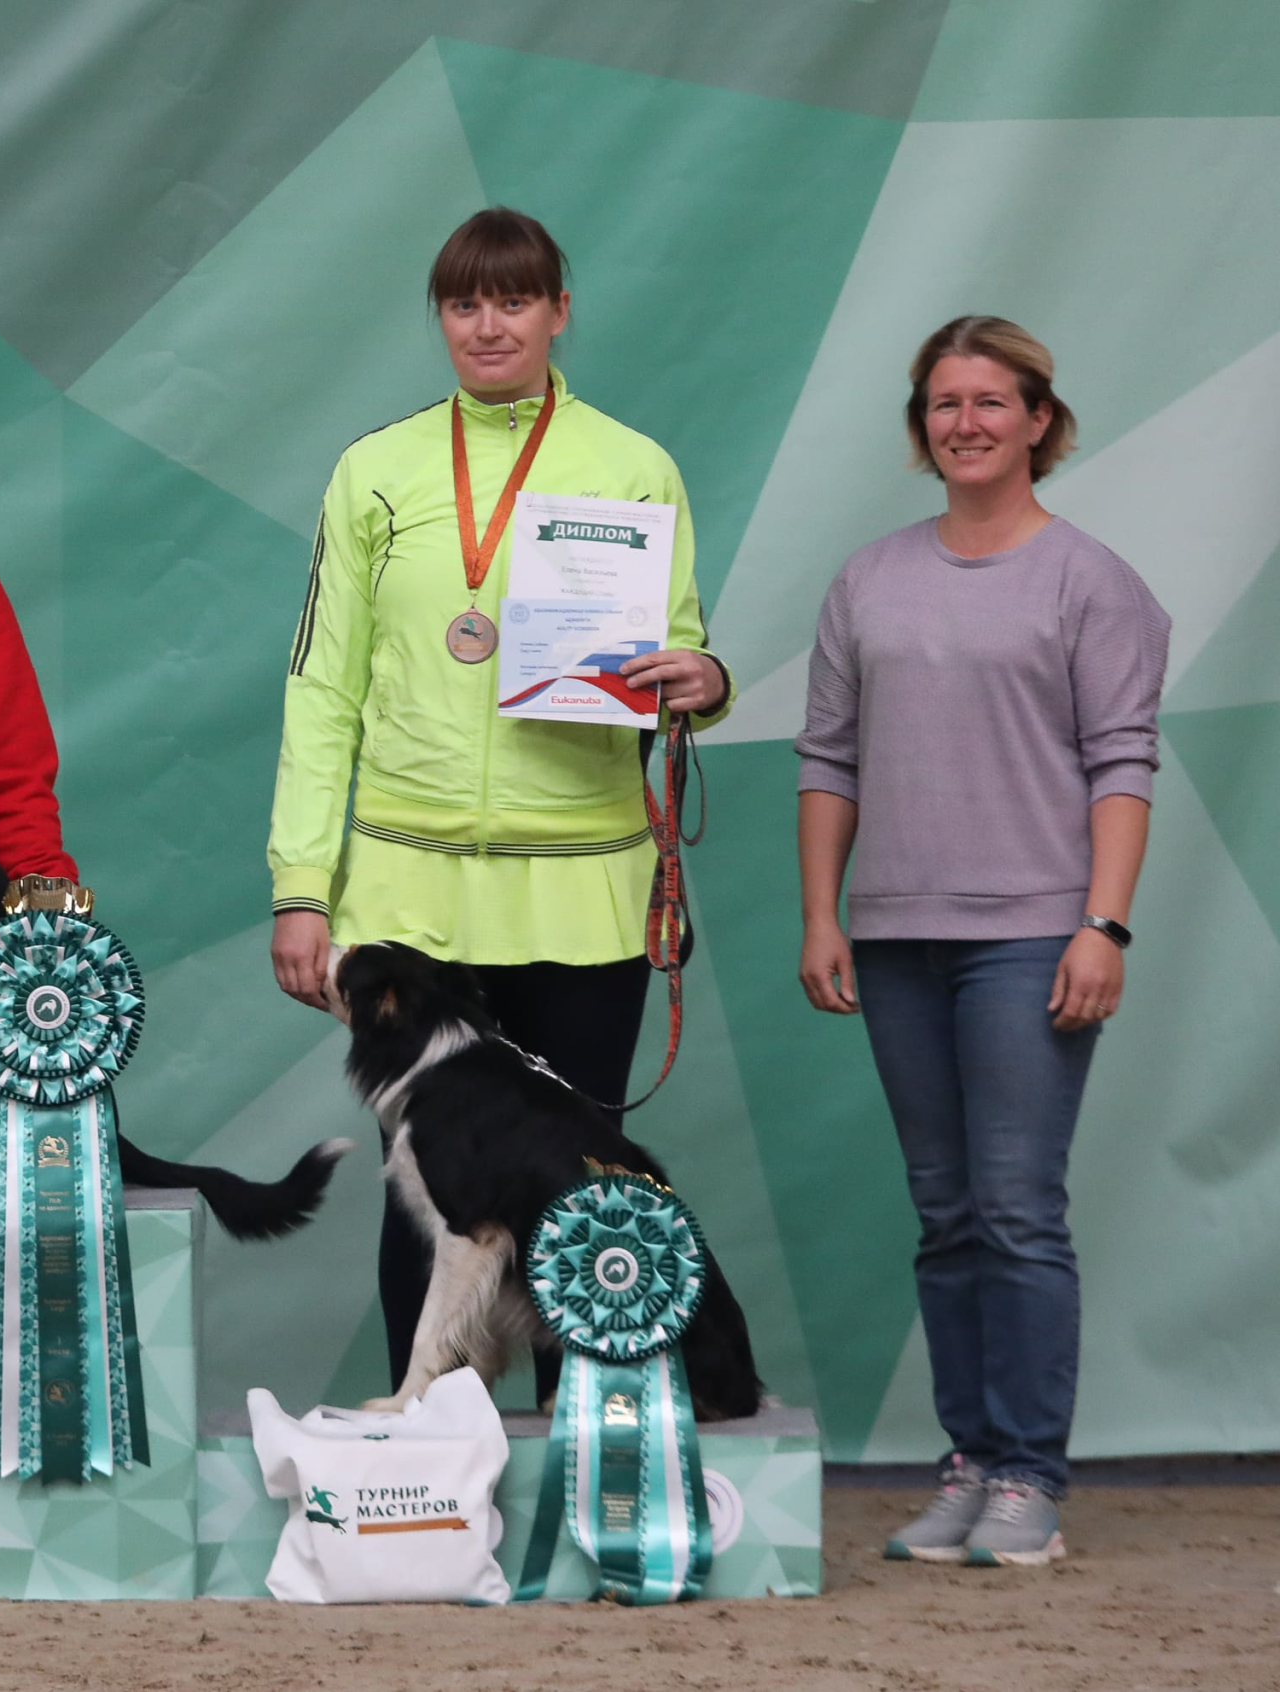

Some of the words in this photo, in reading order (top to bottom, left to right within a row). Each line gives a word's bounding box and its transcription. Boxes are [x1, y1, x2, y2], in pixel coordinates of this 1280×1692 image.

[553, 523, 632, 541] ДИПЛОМ
[550, 695, 602, 705] Eukanuba
[356, 1485, 429, 1502] ТУРНИР
[356, 1499, 459, 1518] МАСТЕРОВ
